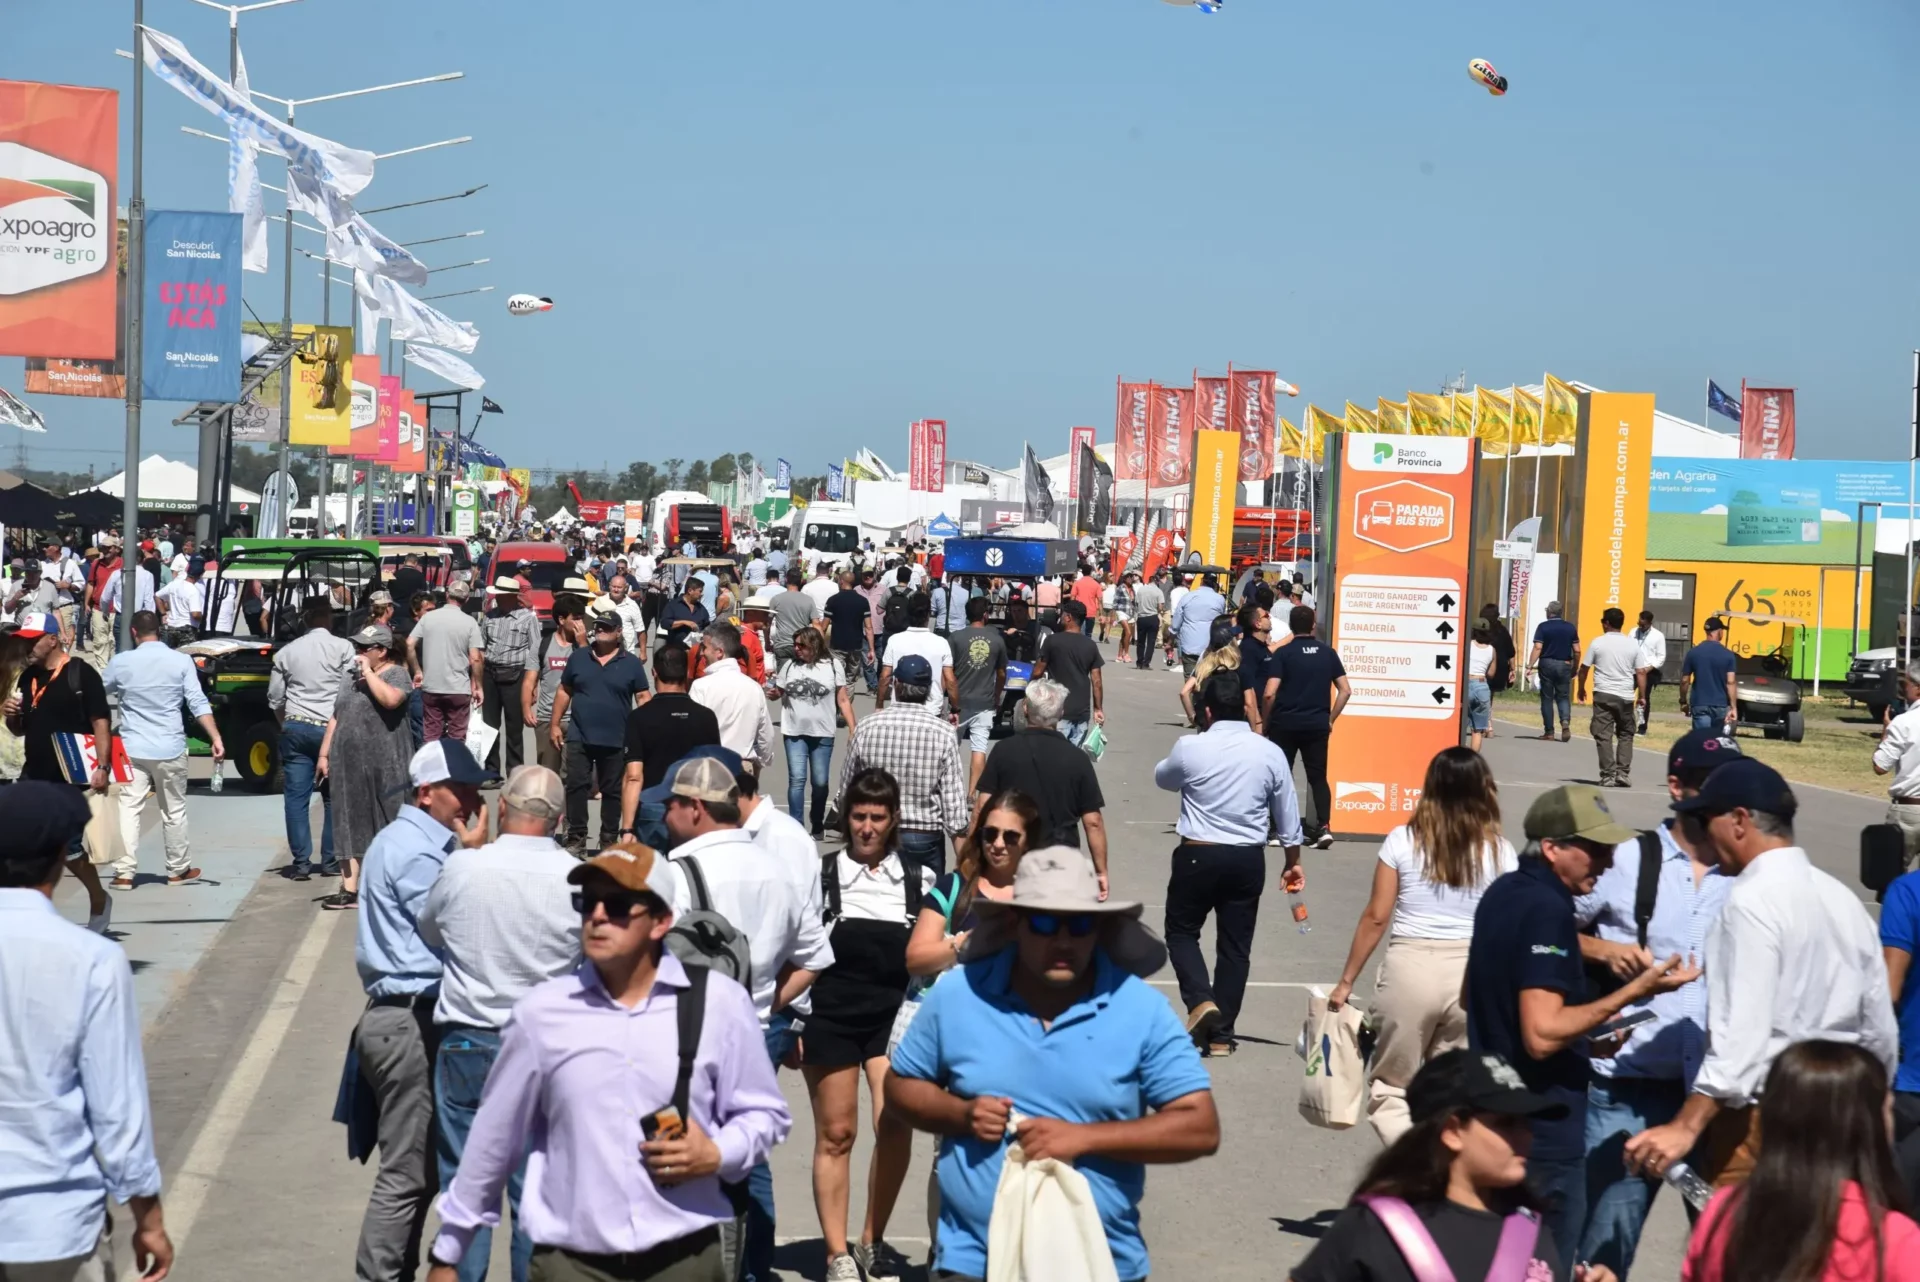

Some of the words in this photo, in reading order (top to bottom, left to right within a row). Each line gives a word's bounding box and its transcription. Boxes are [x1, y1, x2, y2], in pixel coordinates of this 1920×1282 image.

[0, 217, 96, 243] xpoagro
[173, 239, 214, 249] Descubrí
[24, 246, 50, 254] YPF
[53, 248, 96, 264] agro
[166, 249, 184, 257] San
[186, 250, 221, 259] Nicolás
[160, 277, 226, 307] ESTÁS
[166, 352, 183, 364] San
[183, 352, 219, 363] Nicolás
[48, 371, 66, 383] San
[66, 372, 103, 382] Nicolás
[1211, 383, 1227, 431] TINA
[1132, 391, 1147, 448] ALTINA
[1165, 395, 1180, 455] ALTINA
[1398, 449, 1426, 458] Banco
[1397, 458, 1442, 467] Provincia
[1675, 470, 1717, 483] Agraria
[1396, 504, 1444, 517] PARADA
[1395, 516, 1416, 526] BUS
[1418, 517, 1444, 527] STOP
[1346, 591, 1384, 599] AUDITORIO
[1387, 593, 1427, 601] GANADERO
[1784, 588, 1812, 597] AÑOS
[1376, 602, 1421, 610] ARGENTINA"
[1344, 623, 1396, 633] GANADERÍA
[1343, 646, 1365, 654] PLOT
[1732, 640, 1751, 654] de
[1343, 655, 1411, 665] DEMOSTRATIVO
[1336, 800, 1385, 813] Expoagro
